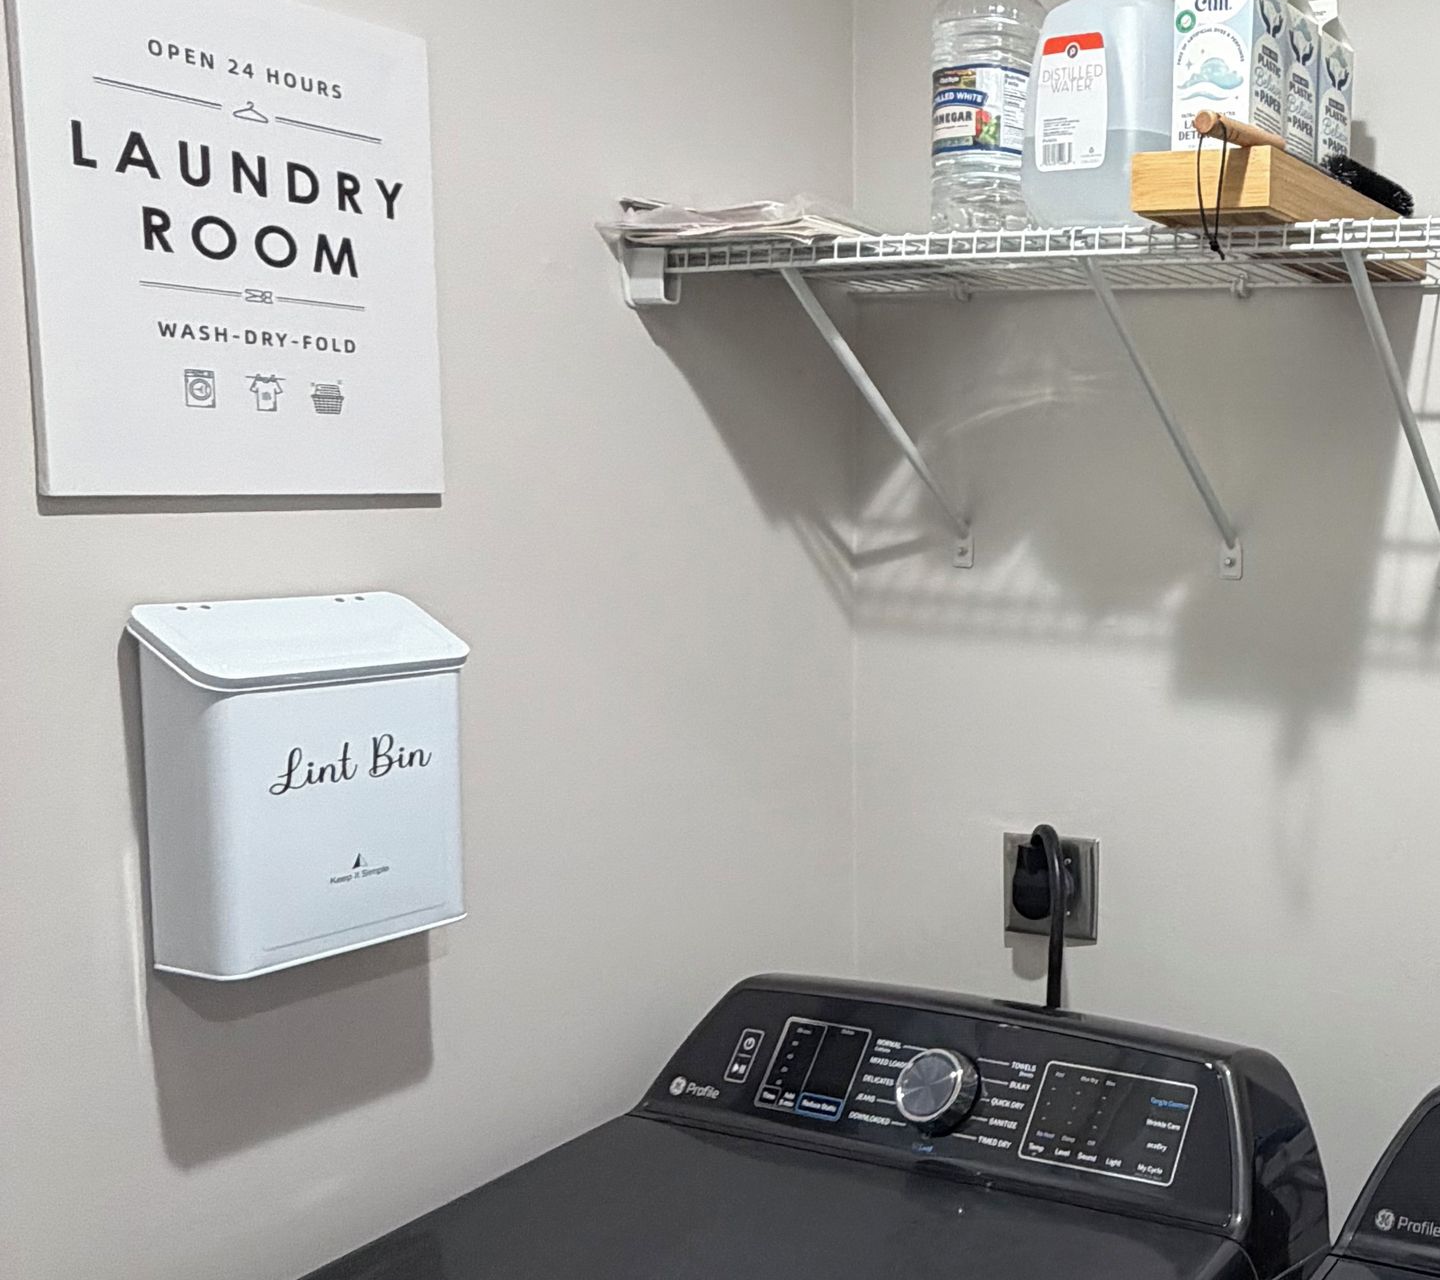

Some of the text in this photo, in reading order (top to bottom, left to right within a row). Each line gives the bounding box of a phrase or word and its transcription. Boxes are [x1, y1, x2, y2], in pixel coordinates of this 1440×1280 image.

[147, 39, 343, 100] OPEN 24 HOURS
[1042, 63, 1104, 83] DISTILLED
[956, 91, 984, 103] WHITE
[1051, 76, 1094, 94] WATER
[935, 110, 972, 125] INEGAR
[70, 119, 404, 220] LAUNDRY
[141, 206, 359, 278] ROOM
[157, 320, 357, 354] WASH-DRY-FOLD
[269, 733, 432, 796] Lint Bin
[1105, 1157, 1122, 1168] Light
